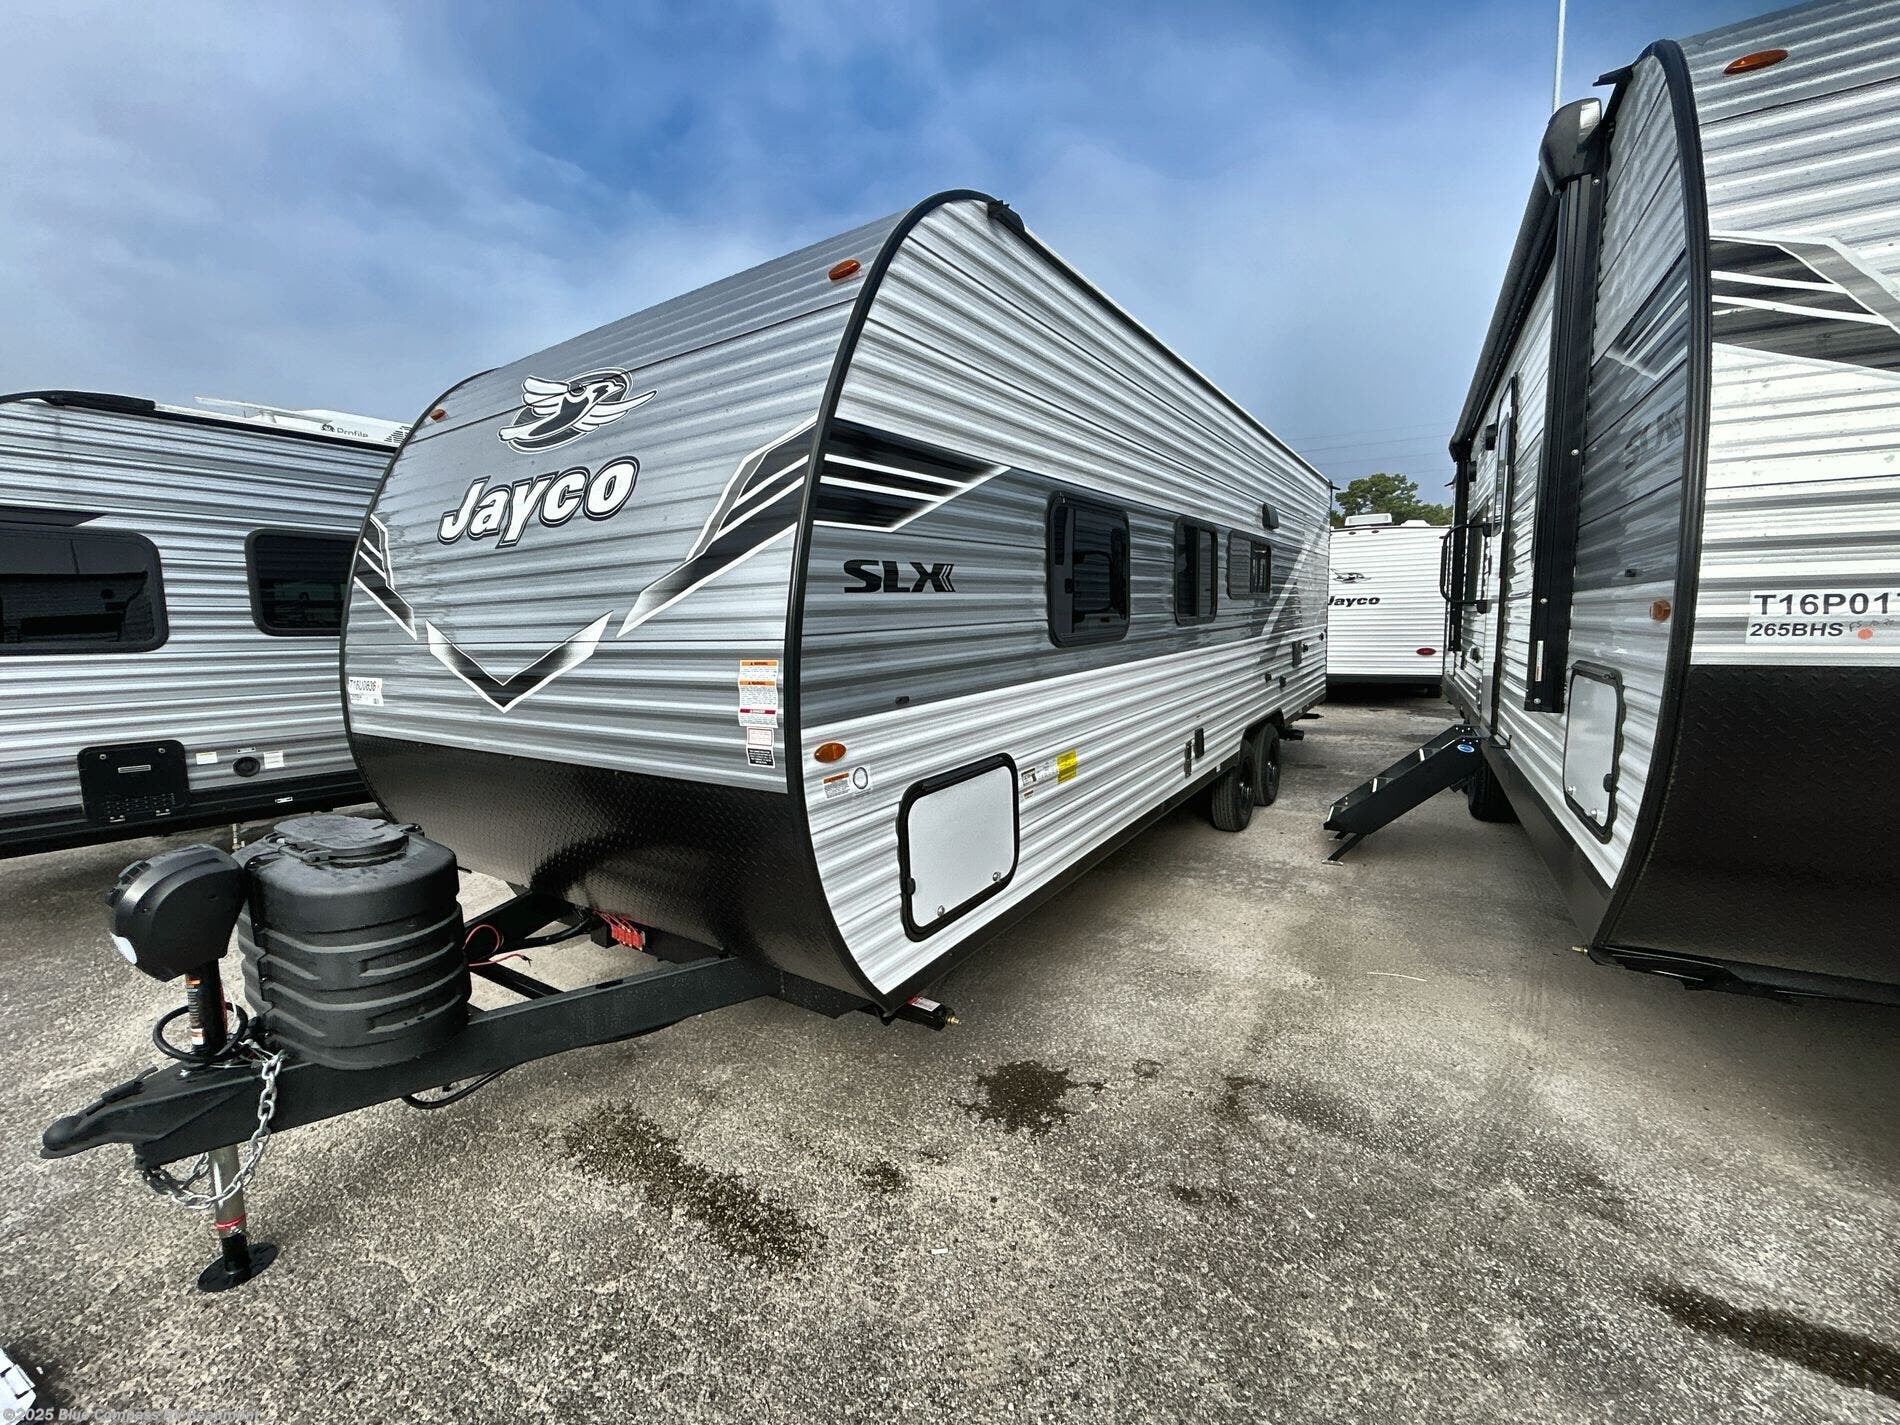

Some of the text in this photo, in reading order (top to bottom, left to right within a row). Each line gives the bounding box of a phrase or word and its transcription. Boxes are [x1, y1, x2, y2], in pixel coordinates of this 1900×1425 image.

[437, 455, 640, 549] Jayco
[843, 559, 956, 594] SLX
[1327, 595, 1381, 608] Jayco
[1753, 592, 1900, 615] T16P01
[1750, 622, 1843, 637] 265BHS
